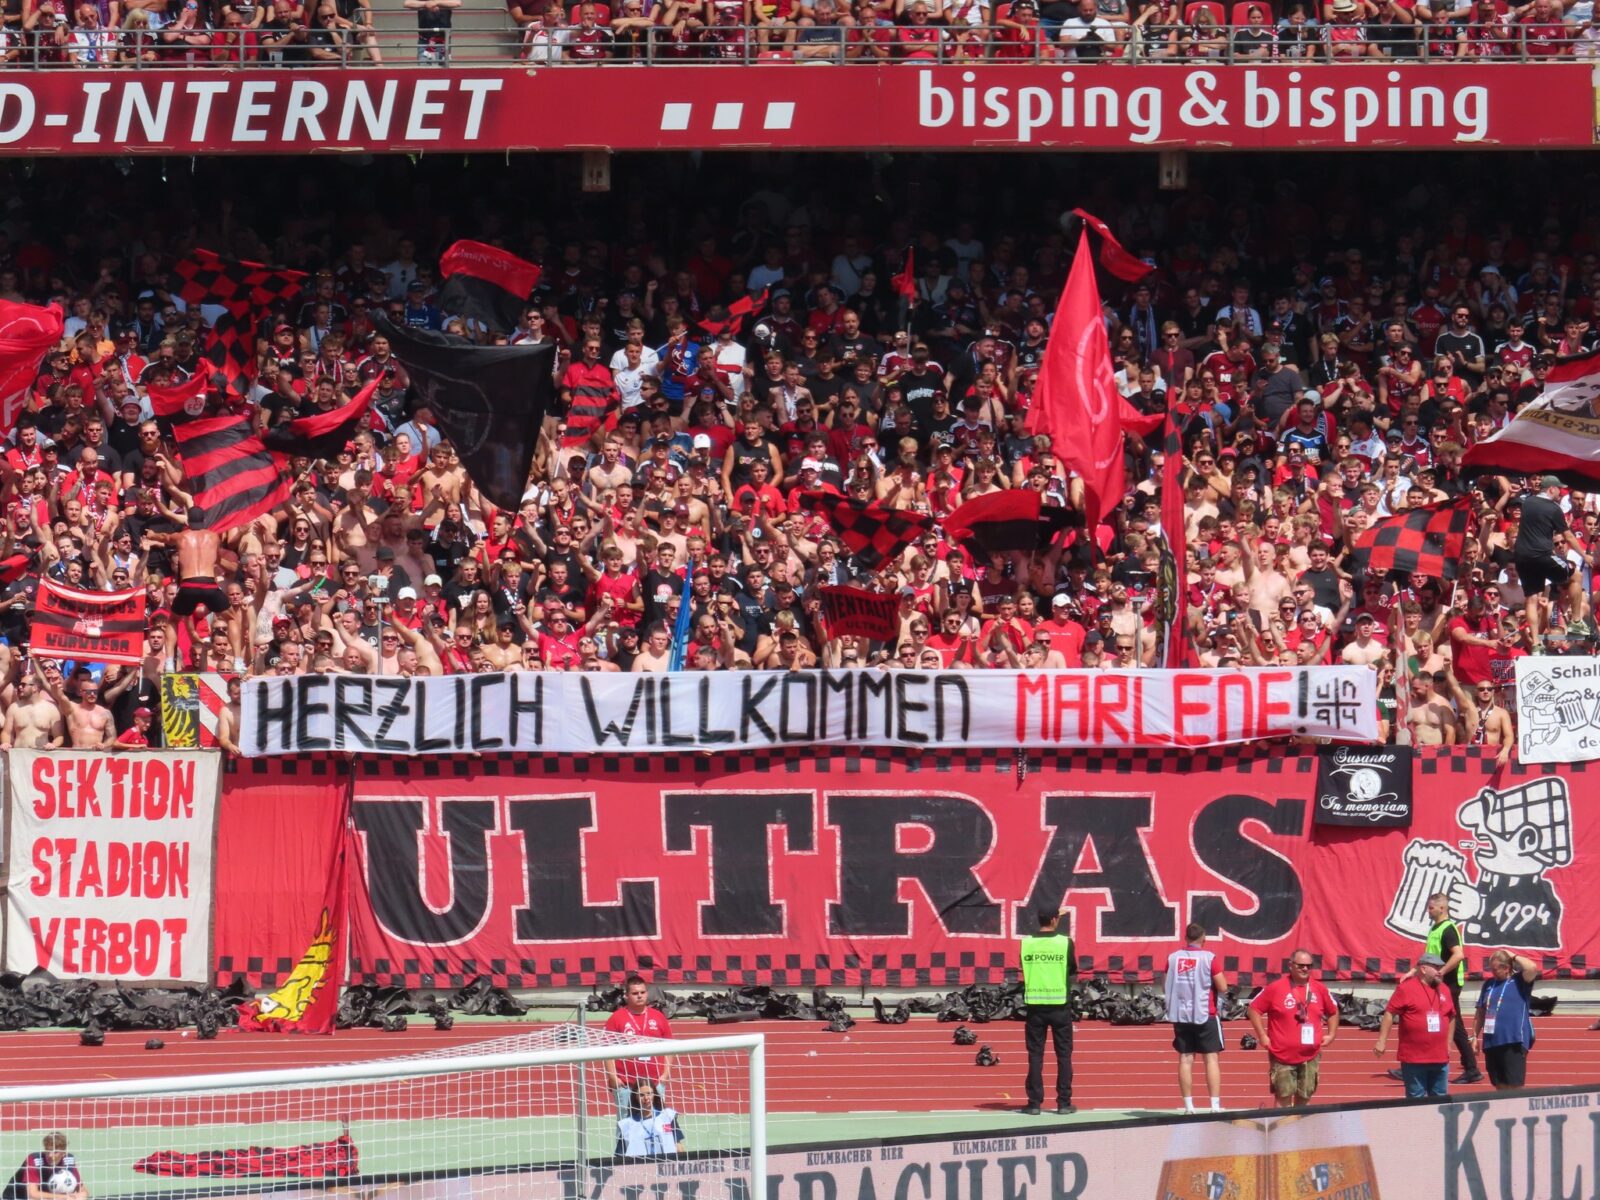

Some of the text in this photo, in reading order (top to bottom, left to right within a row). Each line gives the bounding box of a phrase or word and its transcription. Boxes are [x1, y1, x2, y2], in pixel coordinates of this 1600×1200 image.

[0, 78, 503, 144] D-INTERNET
[919, 70, 1490, 143] bisping & bisping
[256, 673, 543, 751] HERZLICH
[580, 670, 970, 747] WILLKOMMEN
[1333, 746, 1396, 766] Susanne
[31, 756, 195, 821] SEKTION
[1320, 795, 1409, 813] In memoriam
[29, 837, 190, 899] STADION
[354, 789, 1306, 945] ULTRAS
[1490, 900, 1551, 932] 1994
[29, 916, 188, 979] VERBOT
[1528, 1095, 1589, 1110] KULMBACHER
[807, 1147, 904, 1166] KULMBACHER BIER
[953, 1136, 1048, 1155] KULMBACHER BIER
[1438, 1102, 1600, 1200] KUL
